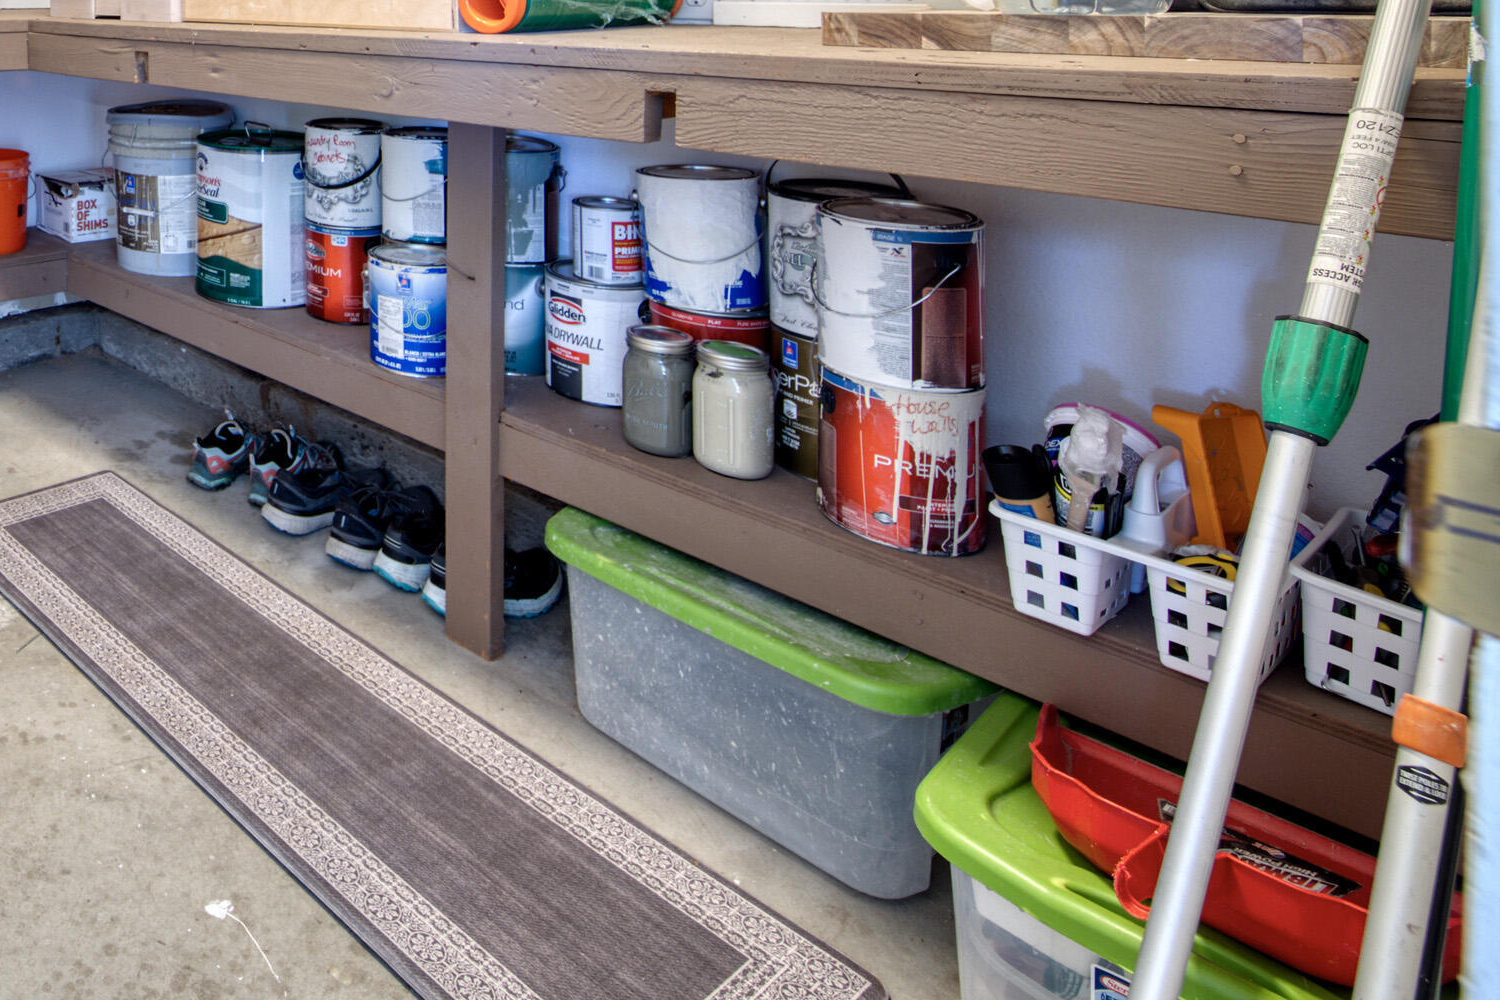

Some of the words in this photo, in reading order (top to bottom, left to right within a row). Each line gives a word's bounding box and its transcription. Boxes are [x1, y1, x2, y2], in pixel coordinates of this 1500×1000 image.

[76, 199, 98, 211] BOX
[76, 210, 90, 221] OF
[76, 218, 109, 232] SHIMS
[306, 262, 342, 278] EMIUM
[1312, 268, 1350, 282] ACCESS
[548, 301, 586, 322] Glidden
[554, 327, 604, 351] DRYWALL
